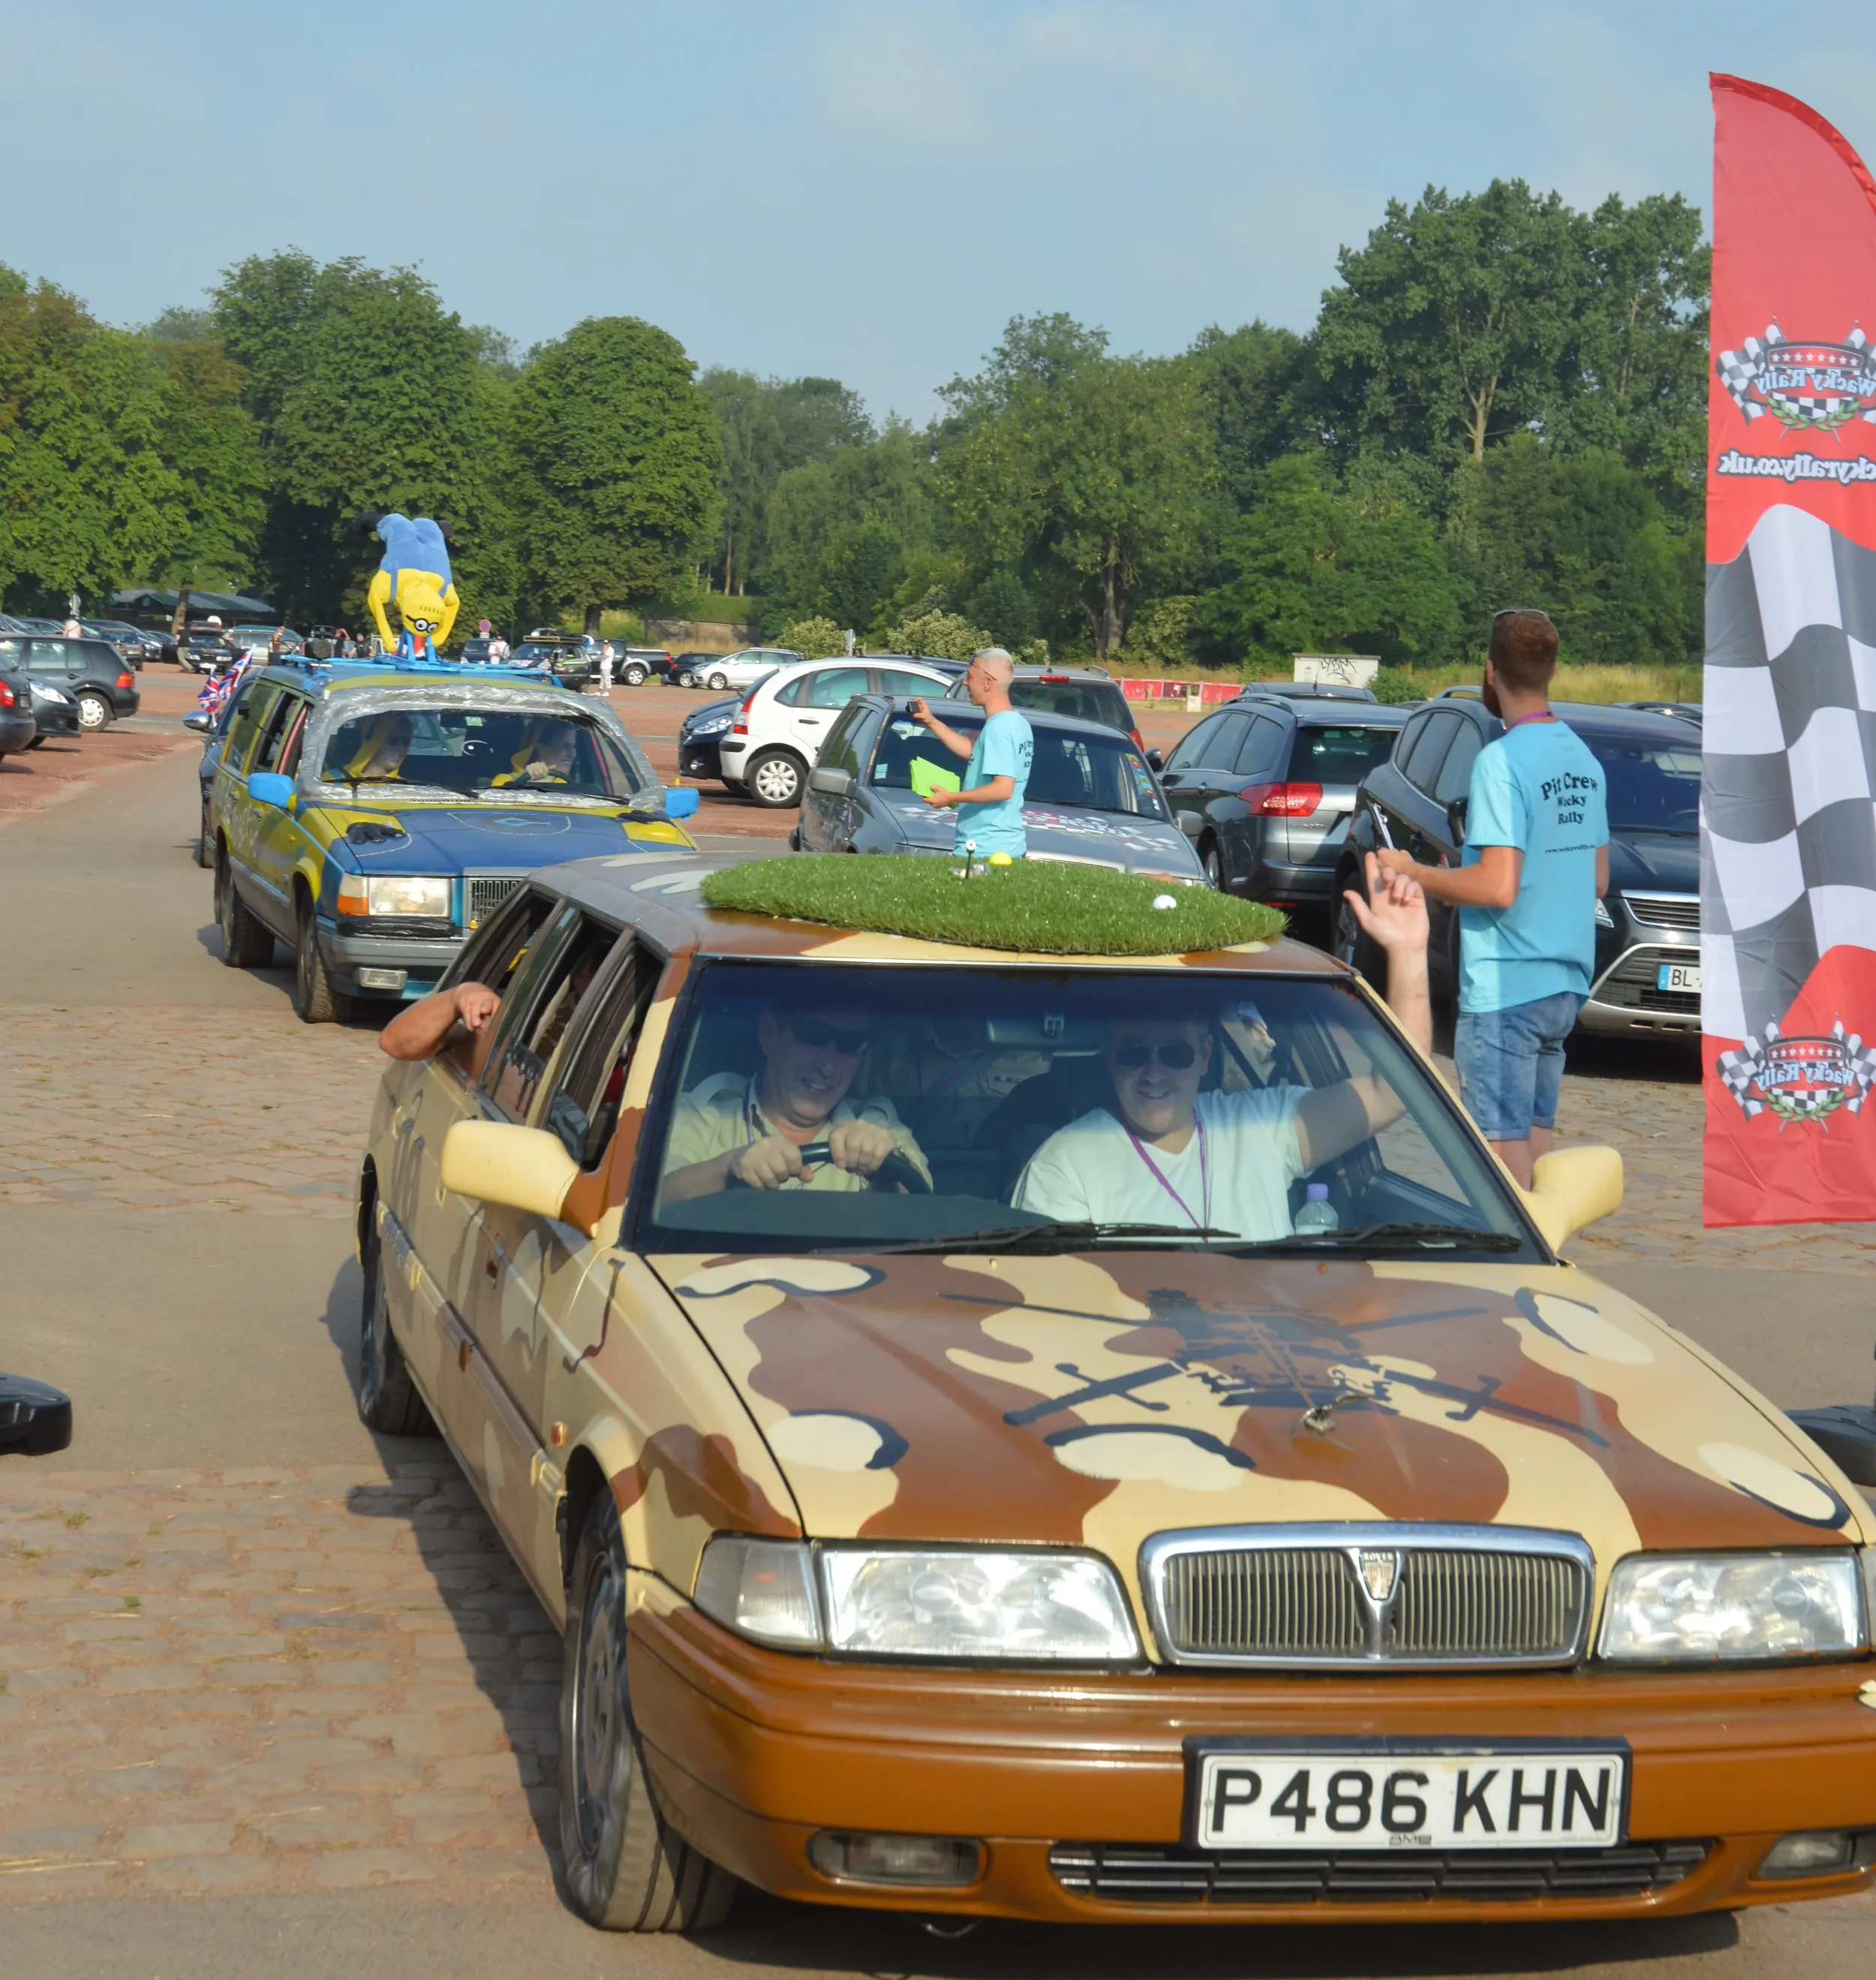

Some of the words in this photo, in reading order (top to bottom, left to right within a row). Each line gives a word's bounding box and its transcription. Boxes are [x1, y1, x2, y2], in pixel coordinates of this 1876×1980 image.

[1541, 778, 1562, 800] Pit
[1563, 772, 1598, 793] Crew
[1557, 794, 1587, 807] Wacky
[1558, 811, 1584, 825] Rally
[1672, 969, 1702, 988] BL-
[1211, 1768, 1430, 1833] P486
[1452, 1768, 1611, 1833] KHN
